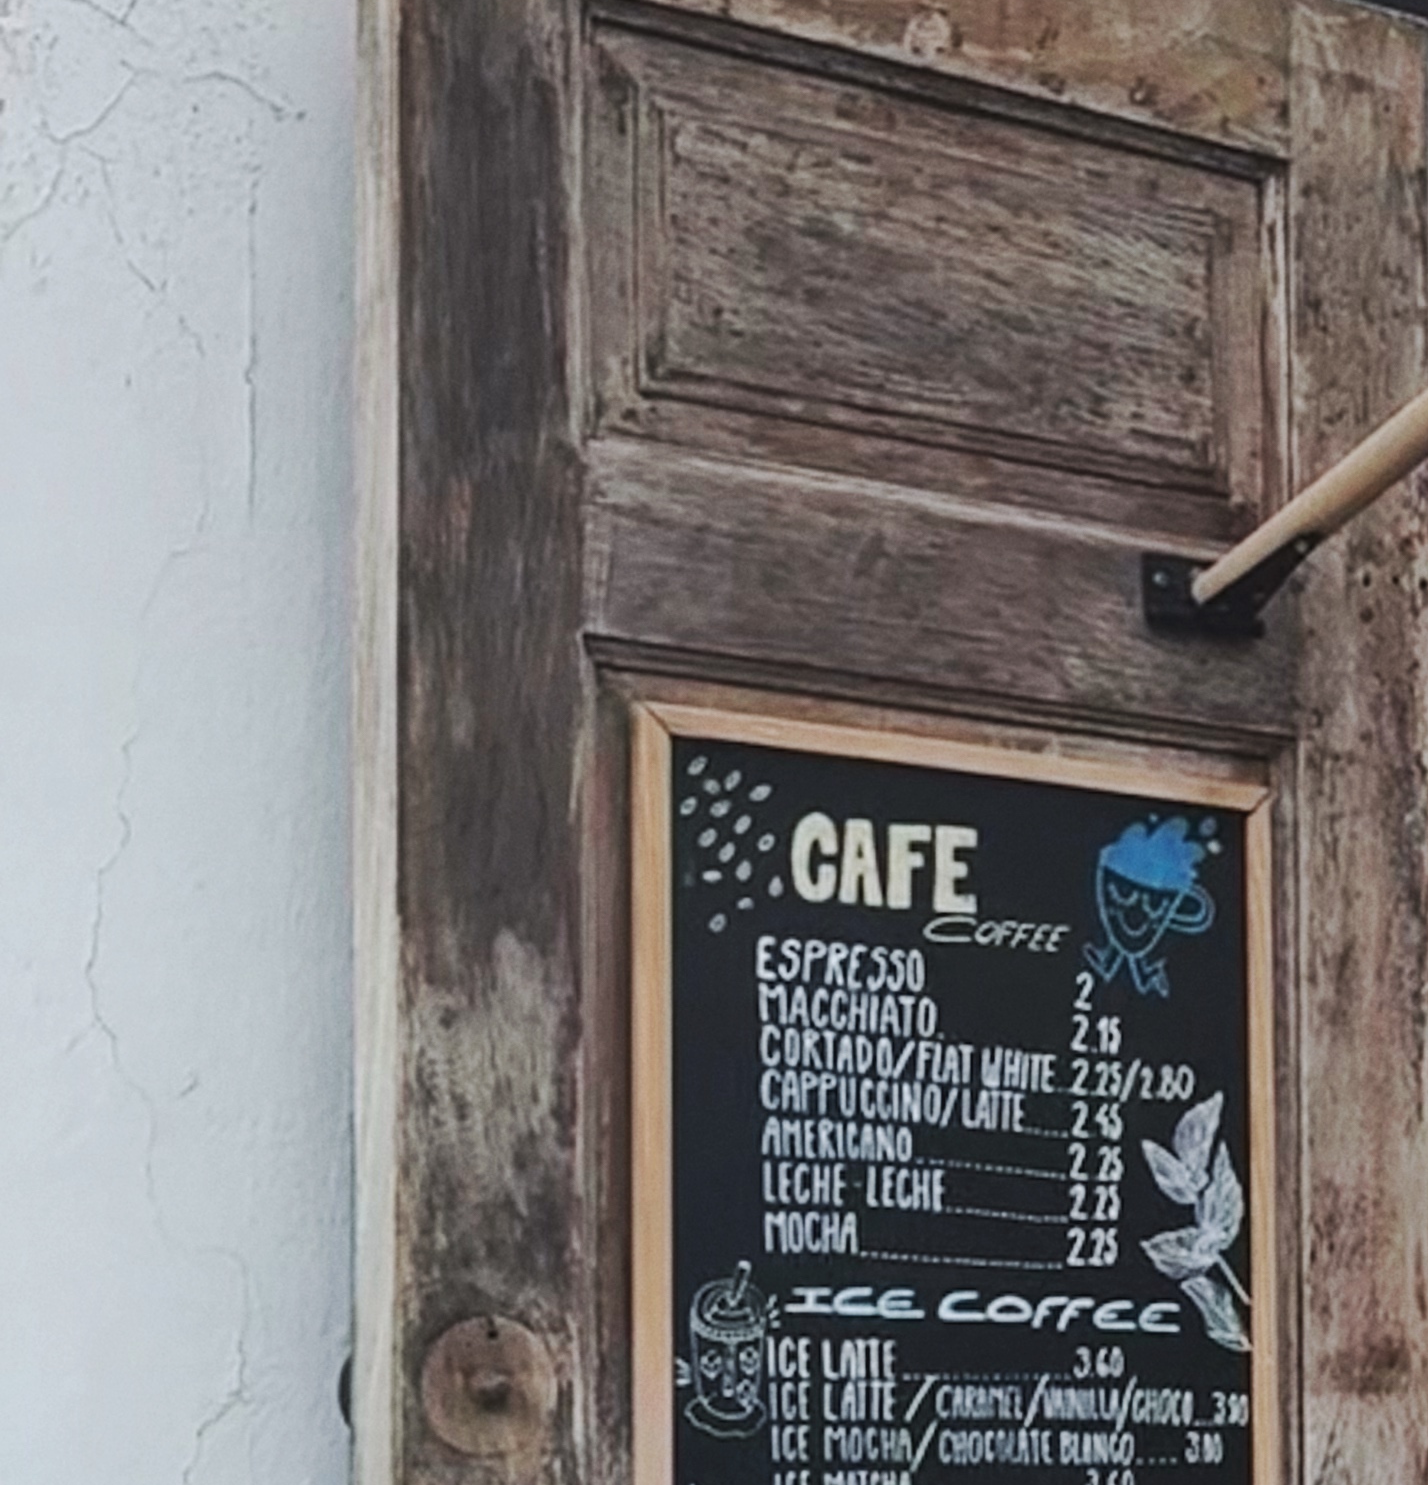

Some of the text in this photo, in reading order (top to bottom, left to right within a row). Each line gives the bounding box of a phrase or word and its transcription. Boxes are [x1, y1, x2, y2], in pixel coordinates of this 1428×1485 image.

[791, 811, 978, 915] CAFE
[922, 915, 1069, 953] COFFEE
[755, 935, 1093, 1011] ESPRESSO 2
[758, 981, 1121, 1055] MACCHIATO 2.15
[980, 1046, 1058, 1093] WHITE
[761, 1116, 914, 1163] AMERICANO
[764, 1211, 859, 1255] MOCHA
[783, 1286, 1181, 1332] ICE COFFEE
[766, 1334, 812, 1379] ICE
[822, 1337, 898, 1382] LATTE
[769, 1380, 811, 1421] ICE
[770, 1424, 811, 1463] ICE
